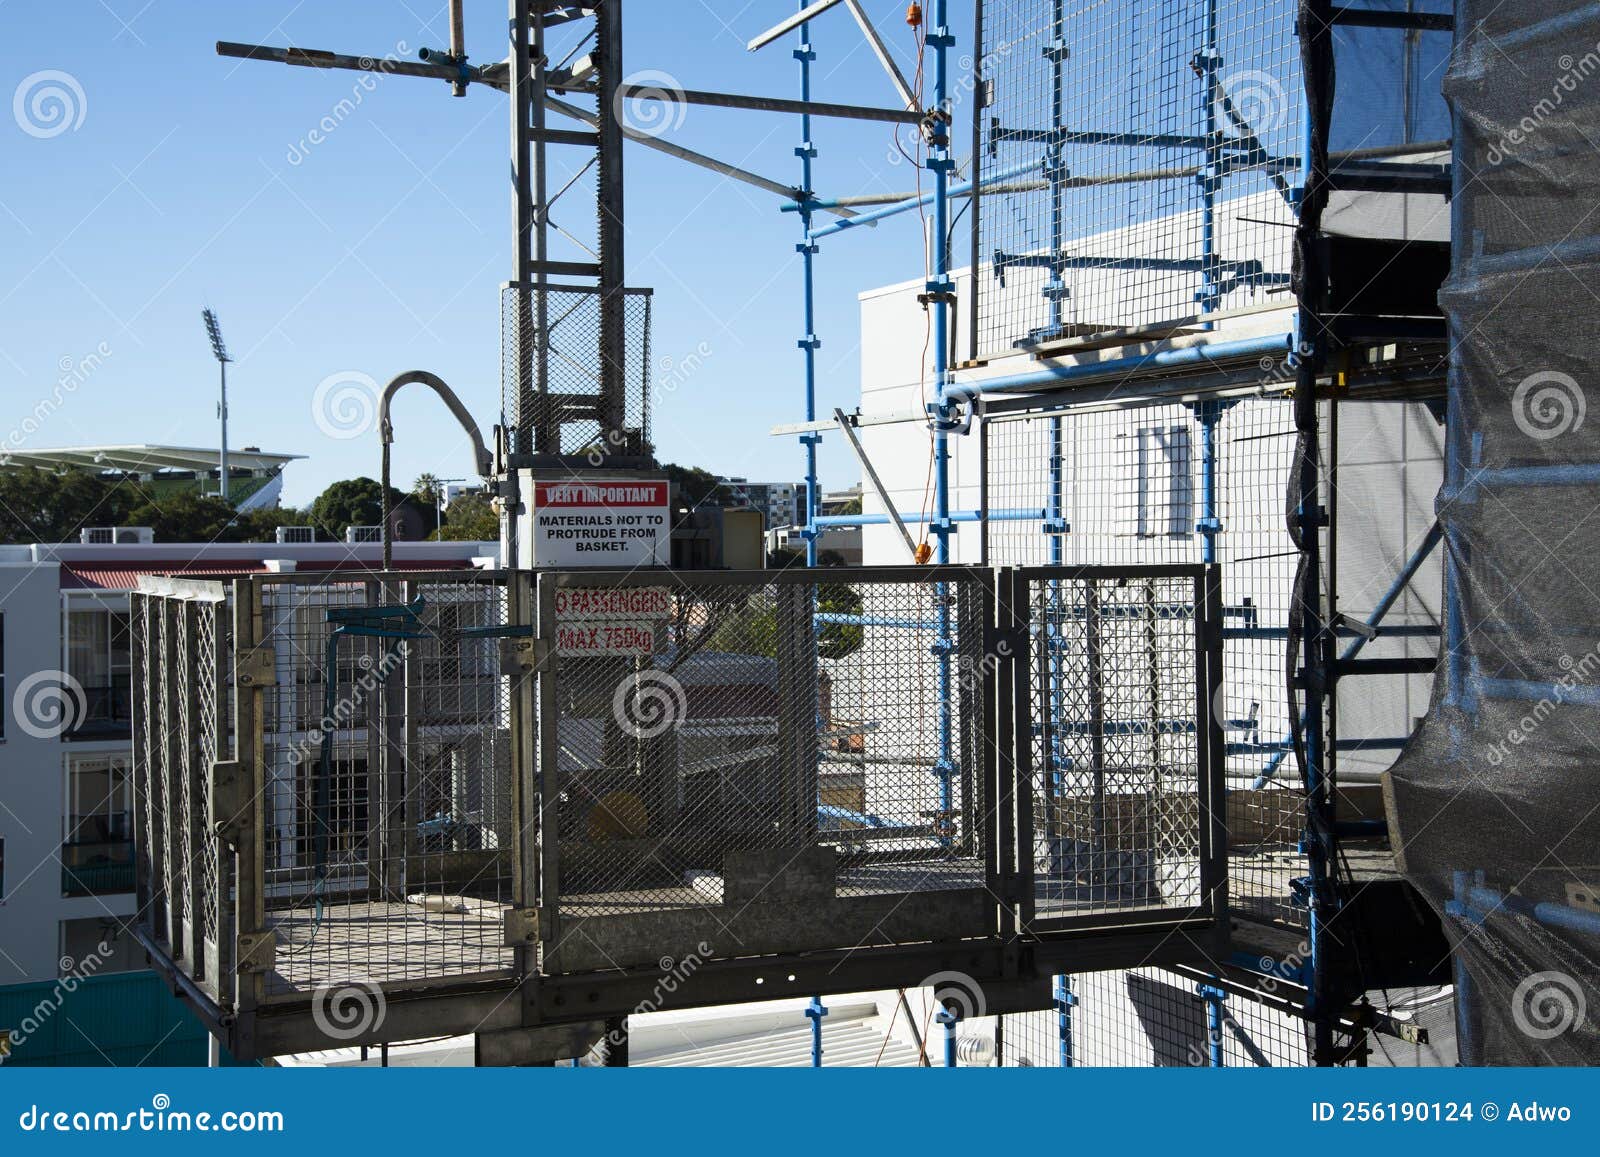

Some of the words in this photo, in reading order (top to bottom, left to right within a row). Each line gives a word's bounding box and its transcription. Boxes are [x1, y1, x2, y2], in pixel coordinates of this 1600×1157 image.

[545, 486, 580, 503] VERY
[581, 487, 657, 503] IMPORTANT
[539, 515, 613, 527] MATERIALS
[616, 515, 643, 526] NOT
[646, 515, 664, 525] TO
[547, 529, 617, 540] PROTRUDE
[620, 528, 656, 538] FROM
[575, 541, 630, 552] BASKET.
[571, 589, 669, 614] PASSENGERS
[559, 627, 600, 650] MAX
[603, 626, 652, 652] 750kg
